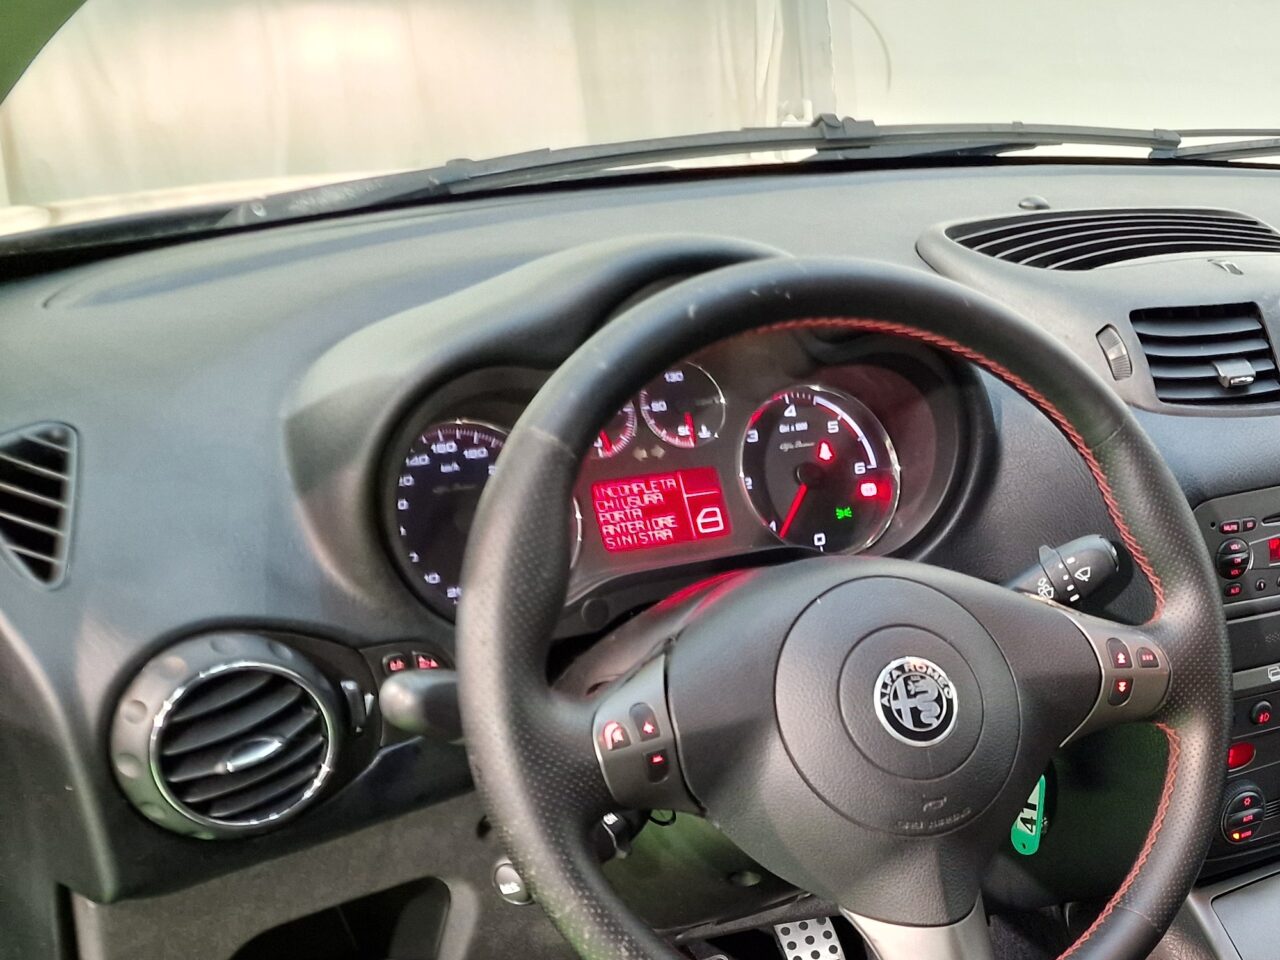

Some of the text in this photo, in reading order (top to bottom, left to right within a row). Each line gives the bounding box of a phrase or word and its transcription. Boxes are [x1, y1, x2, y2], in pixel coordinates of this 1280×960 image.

[784, 404, 797, 417] 4
[827, 420, 839, 433] 5
[746, 429, 759, 442] 3
[854, 462, 866, 474] 6
[593, 478, 677, 498] INCOMPLETA
[595, 492, 664, 513] CHIUSURA
[598, 508, 642, 523] PORTA
[602, 515, 678, 535] ANTERIORE
[606, 529, 673, 549] SINISTRA
[813, 533, 826, 546] 0
[880, 662, 954, 708] ALFA ROMEO
